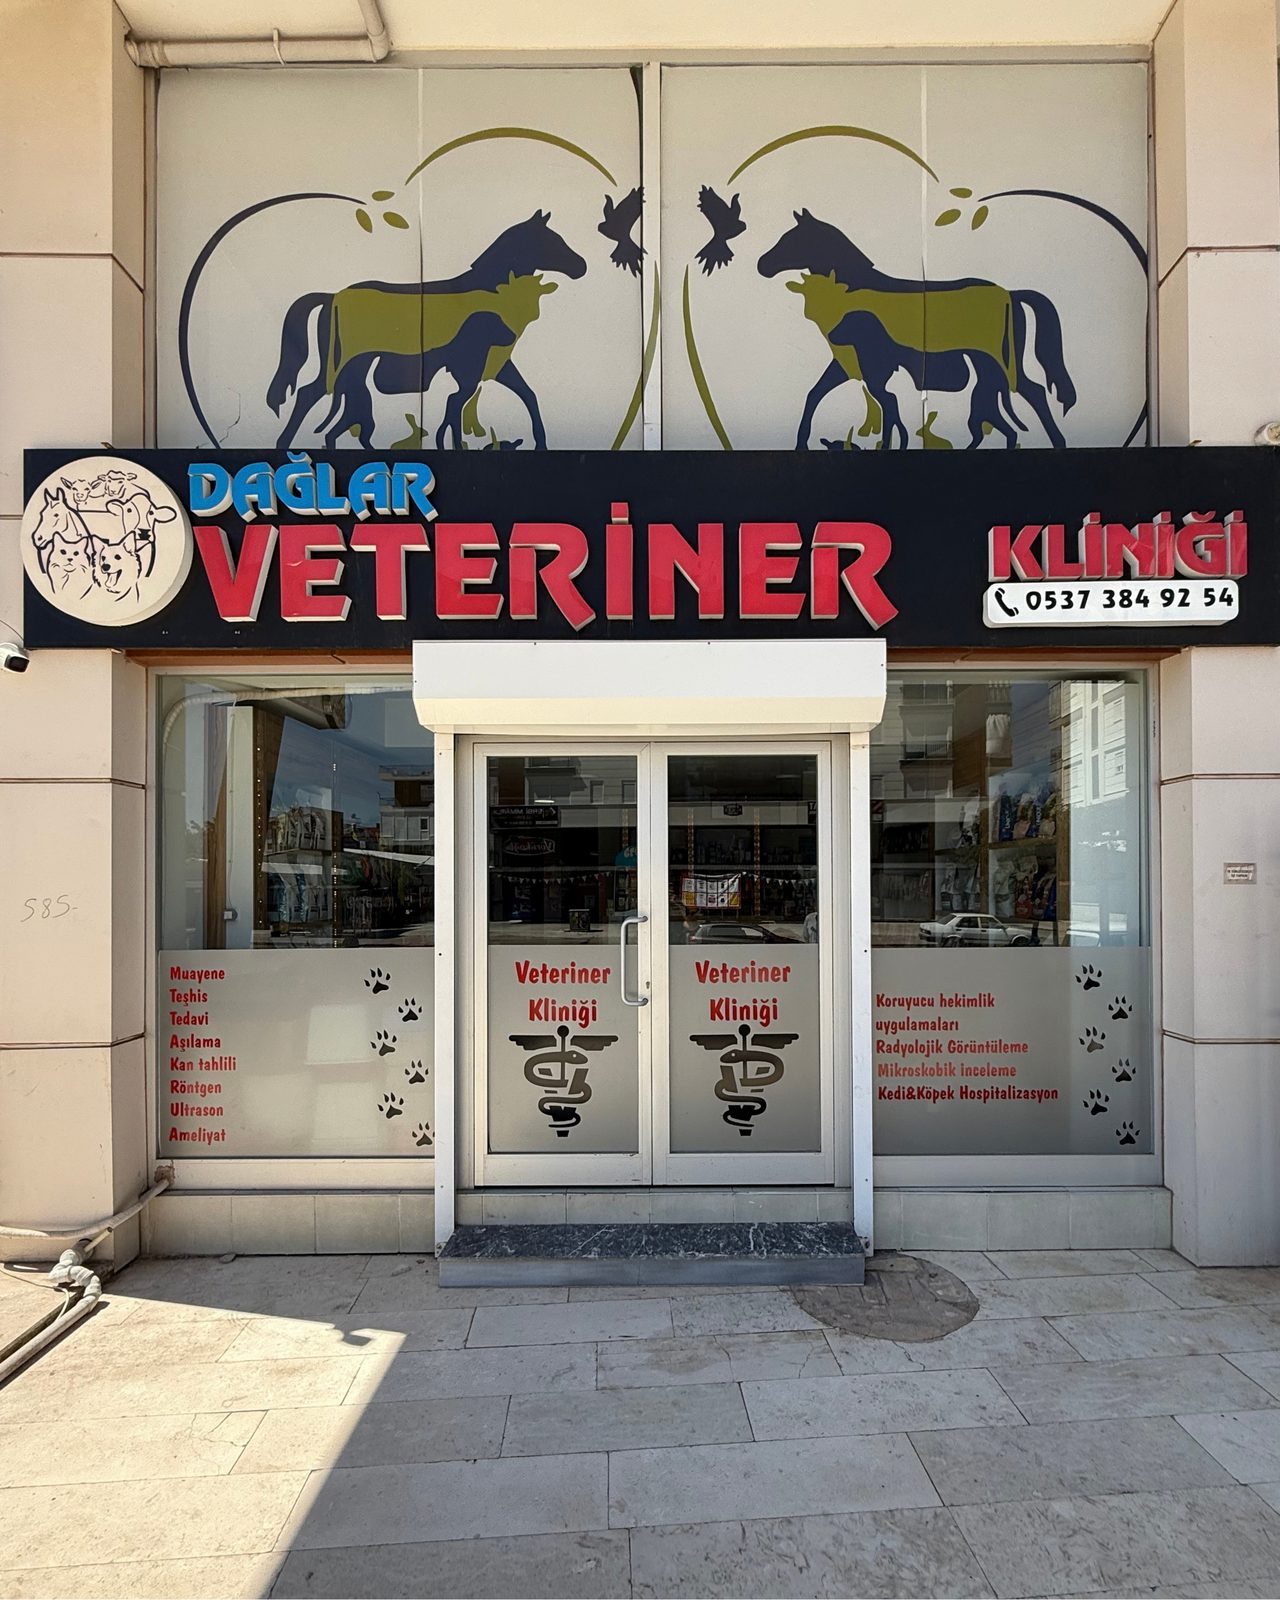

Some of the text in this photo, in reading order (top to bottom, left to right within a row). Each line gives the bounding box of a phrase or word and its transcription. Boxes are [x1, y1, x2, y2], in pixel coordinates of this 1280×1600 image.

[188, 451, 438, 522] DAĞLAR
[193, 502, 1248, 631] VETERİNER KLİNİĞİ
[1025, 587, 1234, 611] 0537 384 92 54
[169, 966, 226, 984] Muayene
[514, 959, 612, 985] Veteriner
[695, 959, 792, 984] Veteriner
[169, 988, 209, 1006] Teşhis
[876, 993, 995, 1011] Koruyucu hekimlik
[169, 1011, 209, 1026] Tedavi
[528, 997, 598, 1029] Kliniği
[709, 997, 778, 1028] Kliniği
[875, 1016, 960, 1034] uygulamaları
[169, 1034, 222, 1052] Aşılama
[876, 1039, 1029, 1057] Radyolojik Görüntüleme
[169, 1056, 237, 1072] Kan tahlili
[878, 1062, 1017, 1077] Mikroskobik inceleme
[169, 1079, 222, 1098] Röntgen
[878, 1085, 1058, 1103] Kedi&Köpek Hospitalizasyon
[169, 1102, 224, 1117] Ultrason
[168, 1127, 227, 1146] Ameliyat
